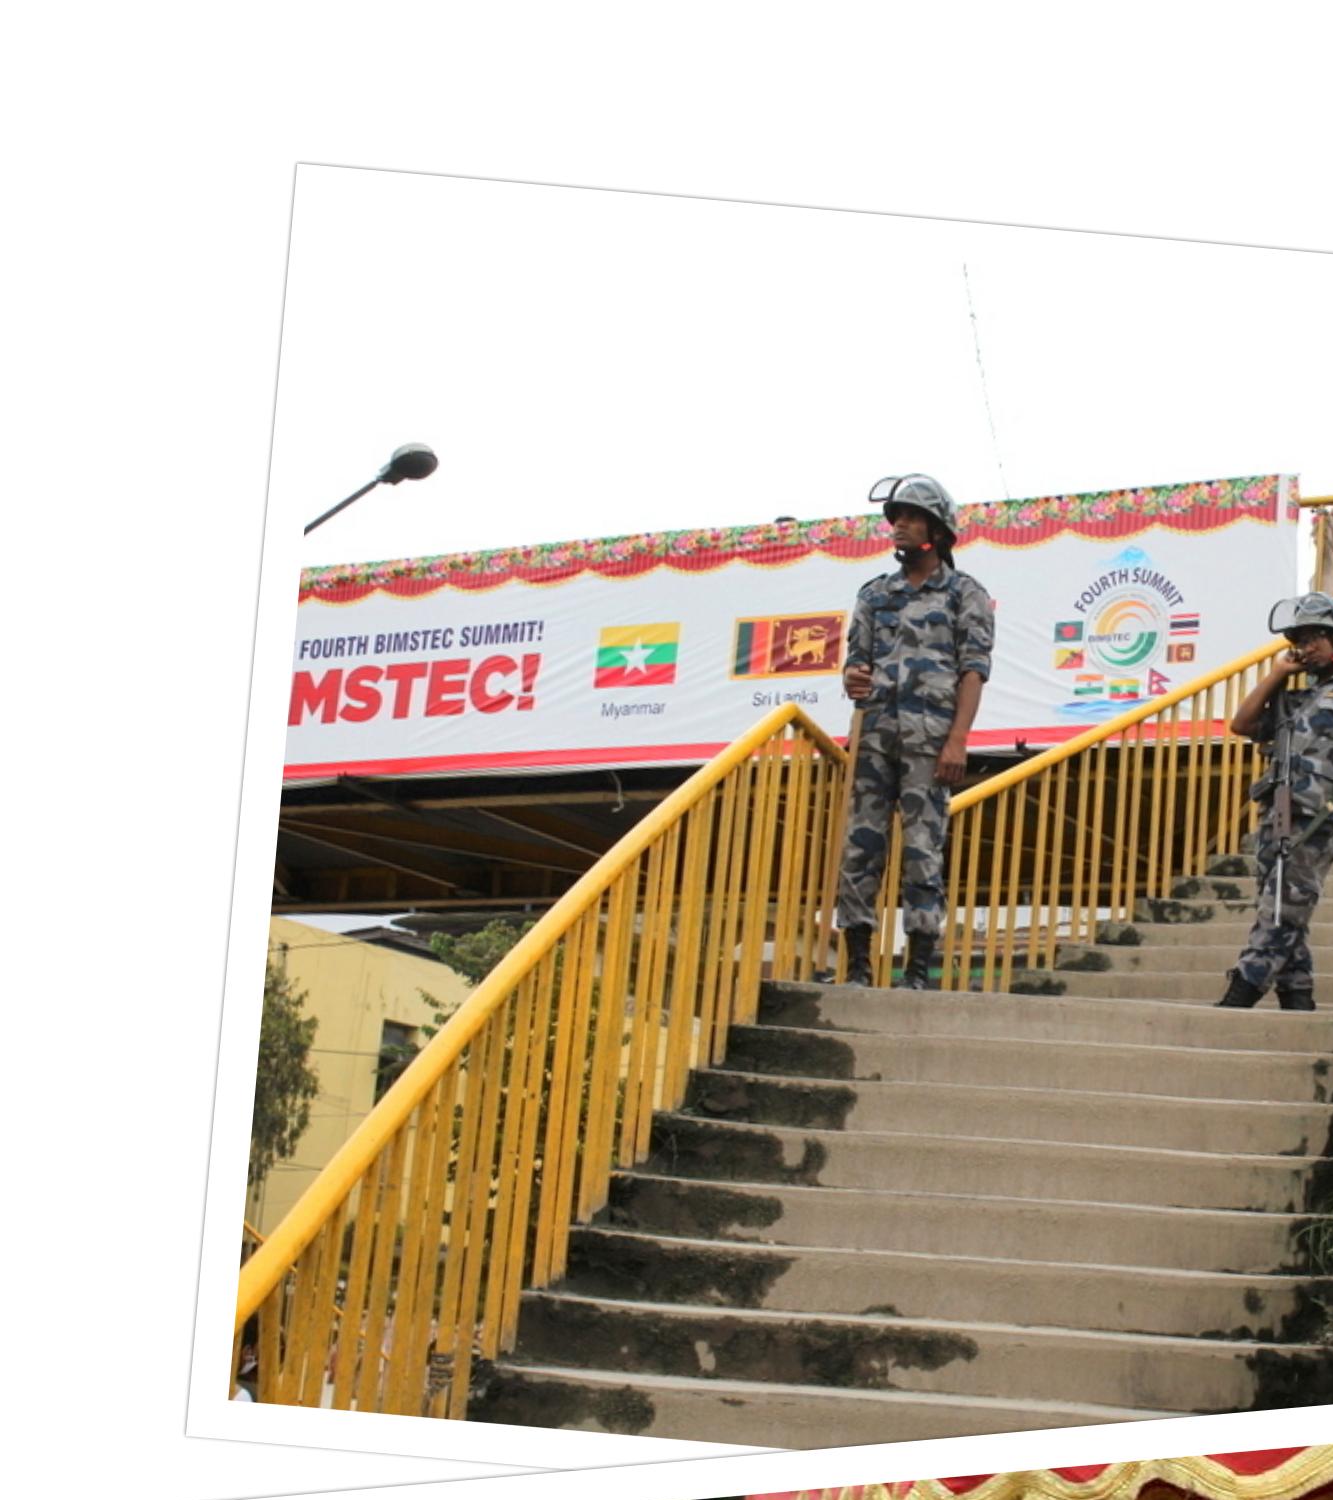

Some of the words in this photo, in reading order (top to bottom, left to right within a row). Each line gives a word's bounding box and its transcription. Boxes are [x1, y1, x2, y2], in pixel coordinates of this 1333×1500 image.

[1073, 568, 1128, 613] FOURTH
[1132, 566, 1184, 607] SUMMIT
[298, 635, 369, 660] FOURTH
[374, 627, 455, 655] BIMSTEC
[459, 620, 545, 648] SUMMIT!
[601, 702, 666, 719] Myanmar
[752, 692, 772, 707] Sri
